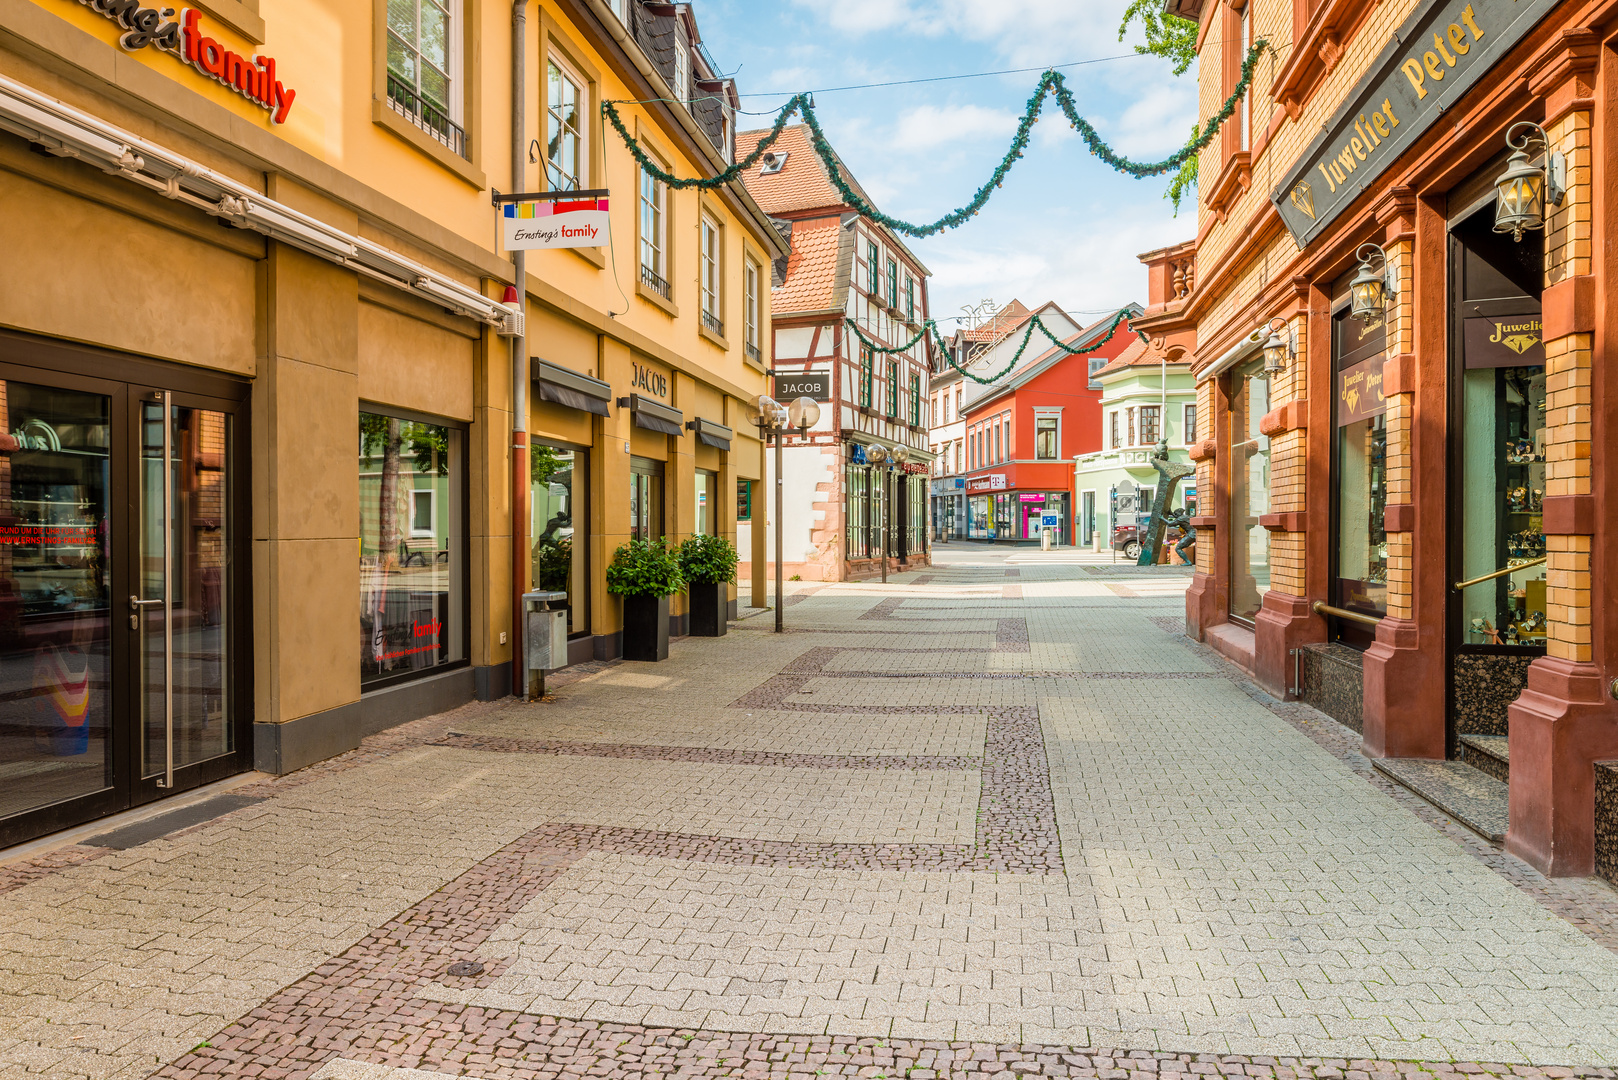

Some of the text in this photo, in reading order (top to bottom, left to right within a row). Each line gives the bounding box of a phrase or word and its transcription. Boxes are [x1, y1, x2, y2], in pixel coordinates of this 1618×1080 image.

[182, 8, 296, 125] family
[1318, 4, 1485, 193] Juwelier Peter
[514, 223, 599, 243] Ernsting's family
[631, 361, 667, 397] JACOB
[782, 383, 822, 394] JACOB
[1342, 370, 1365, 401] Juwelier
[1366, 373, 1383, 393] Peter
[0, 526, 20, 535] RUND
[21, 527, 32, 535] UM
[33, 527, 44, 535] DIE
[45, 527, 60, 535] UHR
[61, 526, 74, 535] FÜR
[413, 617, 442, 637] family
